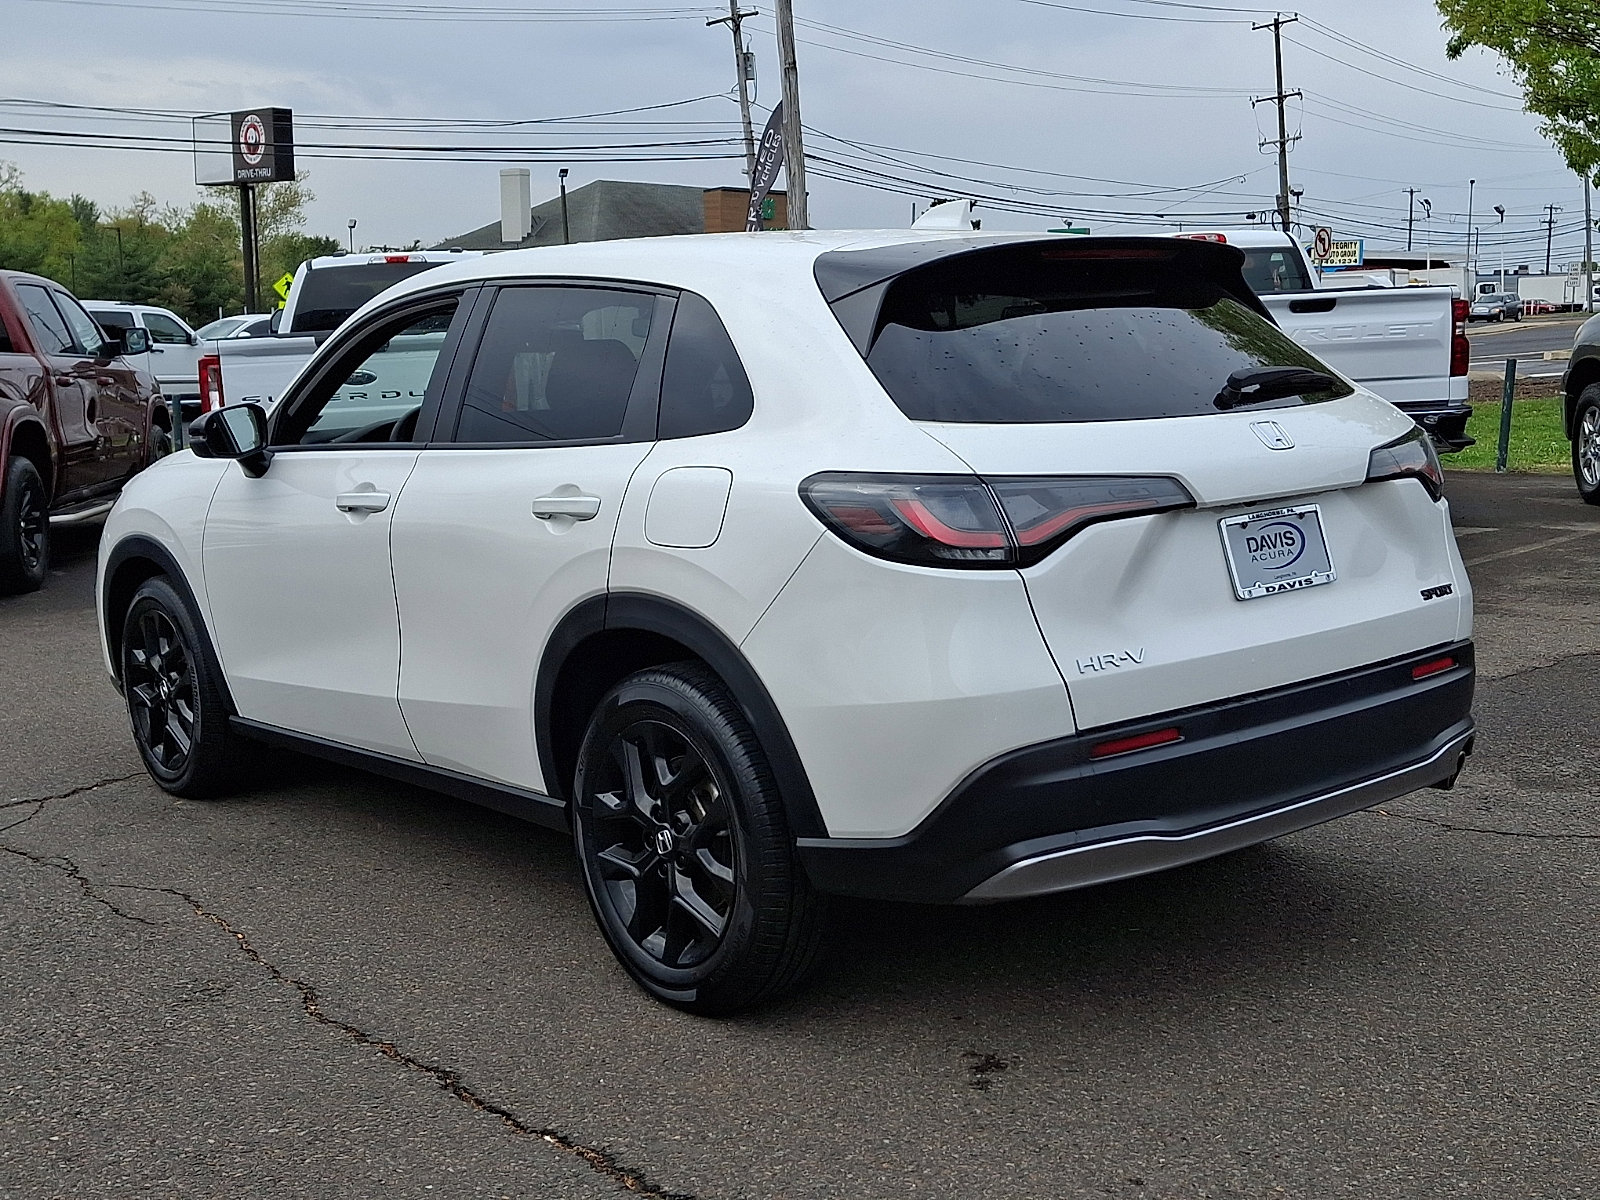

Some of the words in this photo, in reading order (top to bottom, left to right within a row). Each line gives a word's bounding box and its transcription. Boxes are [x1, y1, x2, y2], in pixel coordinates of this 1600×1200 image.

[757, 133, 782, 188] VEHICLES
[237, 168, 272, 179] DRIVE-THRU
[1331, 241, 1358, 250] TEGRITY
[1246, 530, 1296, 554] DAVIS
[1251, 548, 1295, 563] ACURA
[1265, 578, 1314, 593] DAVIS
[1076, 647, 1144, 674] HR-V
